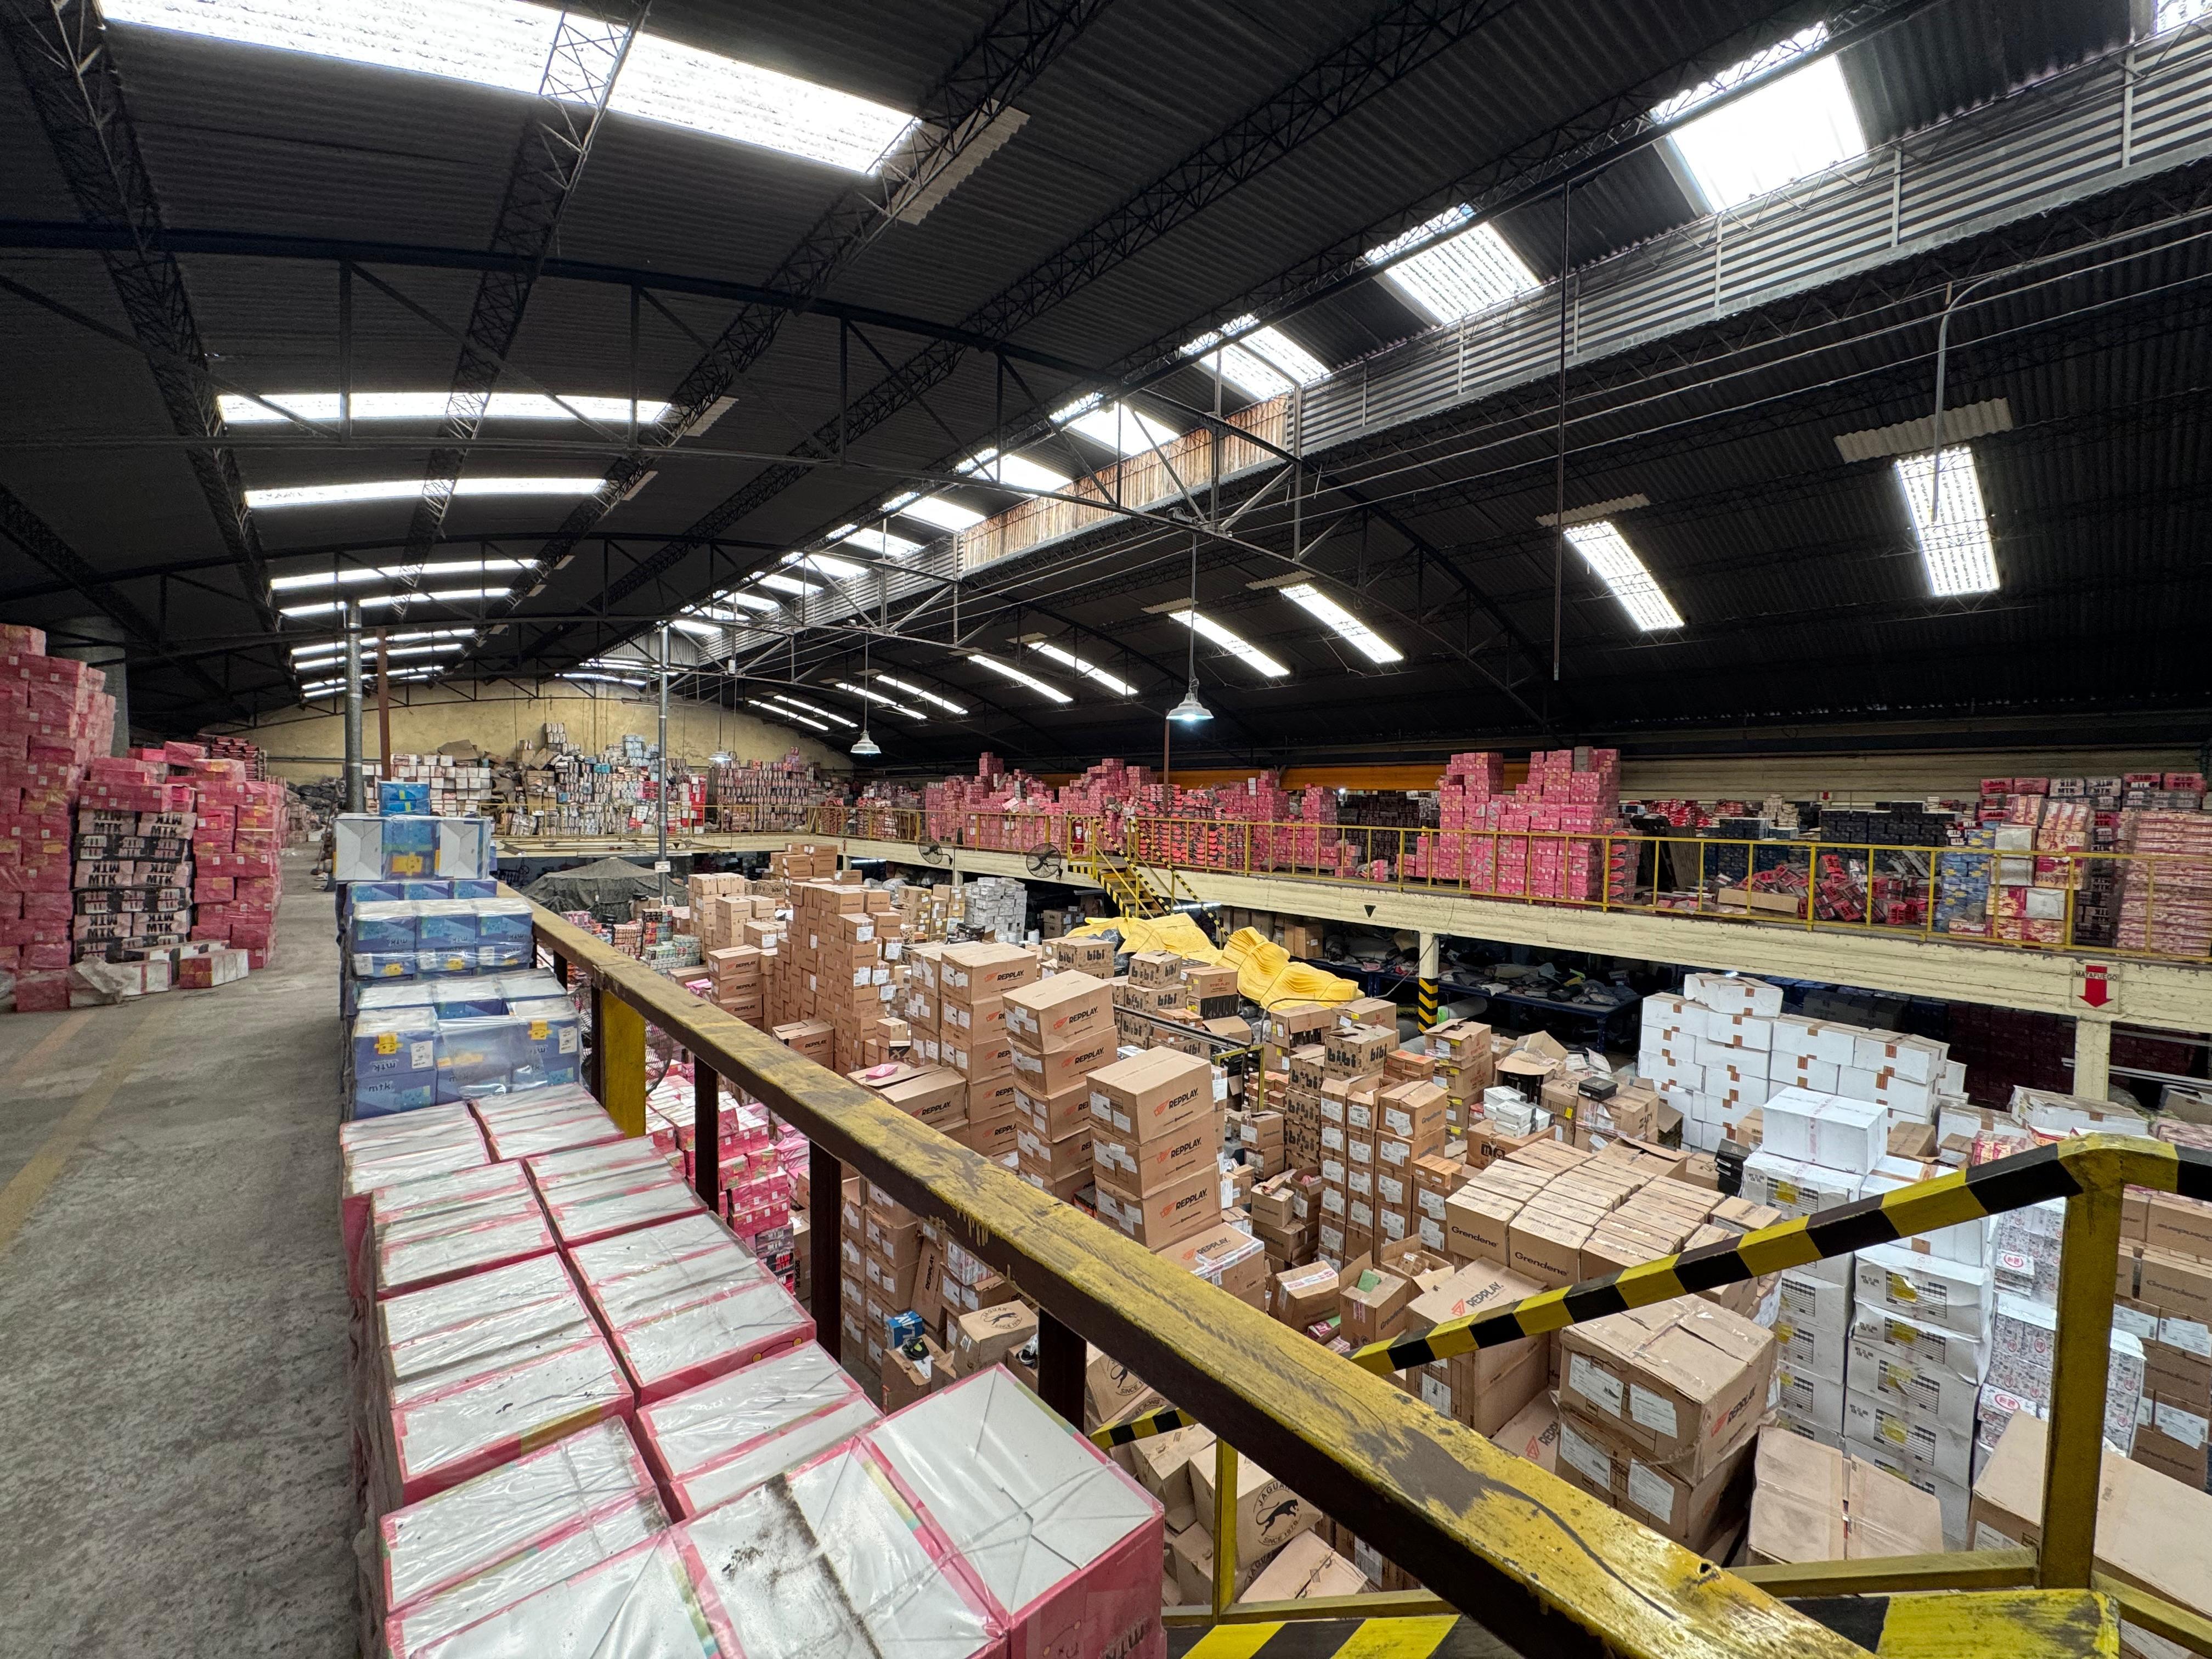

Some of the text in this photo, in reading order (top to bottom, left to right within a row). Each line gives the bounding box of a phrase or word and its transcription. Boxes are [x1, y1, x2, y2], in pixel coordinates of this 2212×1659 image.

[94, 823, 121, 833] MTK
[151, 826, 177, 836] MTK
[88, 875, 116, 885] MTK
[146, 875, 173, 884] MTK
[87, 928, 115, 938] MTK
[147, 923, 172, 932] MTK
[1087, 949, 1105, 961] bibi
[1165, 963, 1177, 977] bibi
[2075, 970, 2117, 980] MATAFUEGO
[1158, 993, 1177, 1006] bibi
[1327, 1047, 1356, 1068] bibi
[1370, 1043, 1387, 1062] bibi
[373, 1060, 397, 1072] mtk
[368, 1082, 392, 1092] mtk
[996, 1086, 1014, 1097] REPPL
[994, 1124, 1016, 1136] REPPLA
[1452, 1226, 1498, 1248] Grendene
[1514, 1251, 1568, 1277] Grendene
[2146, 1279, 2208, 1301] Grendene
[1120, 1384, 1138, 1394] SINCE
[1538, 1421, 1559, 1447] REPP
[1263, 1520, 1299, 1544] SINCE 1979
